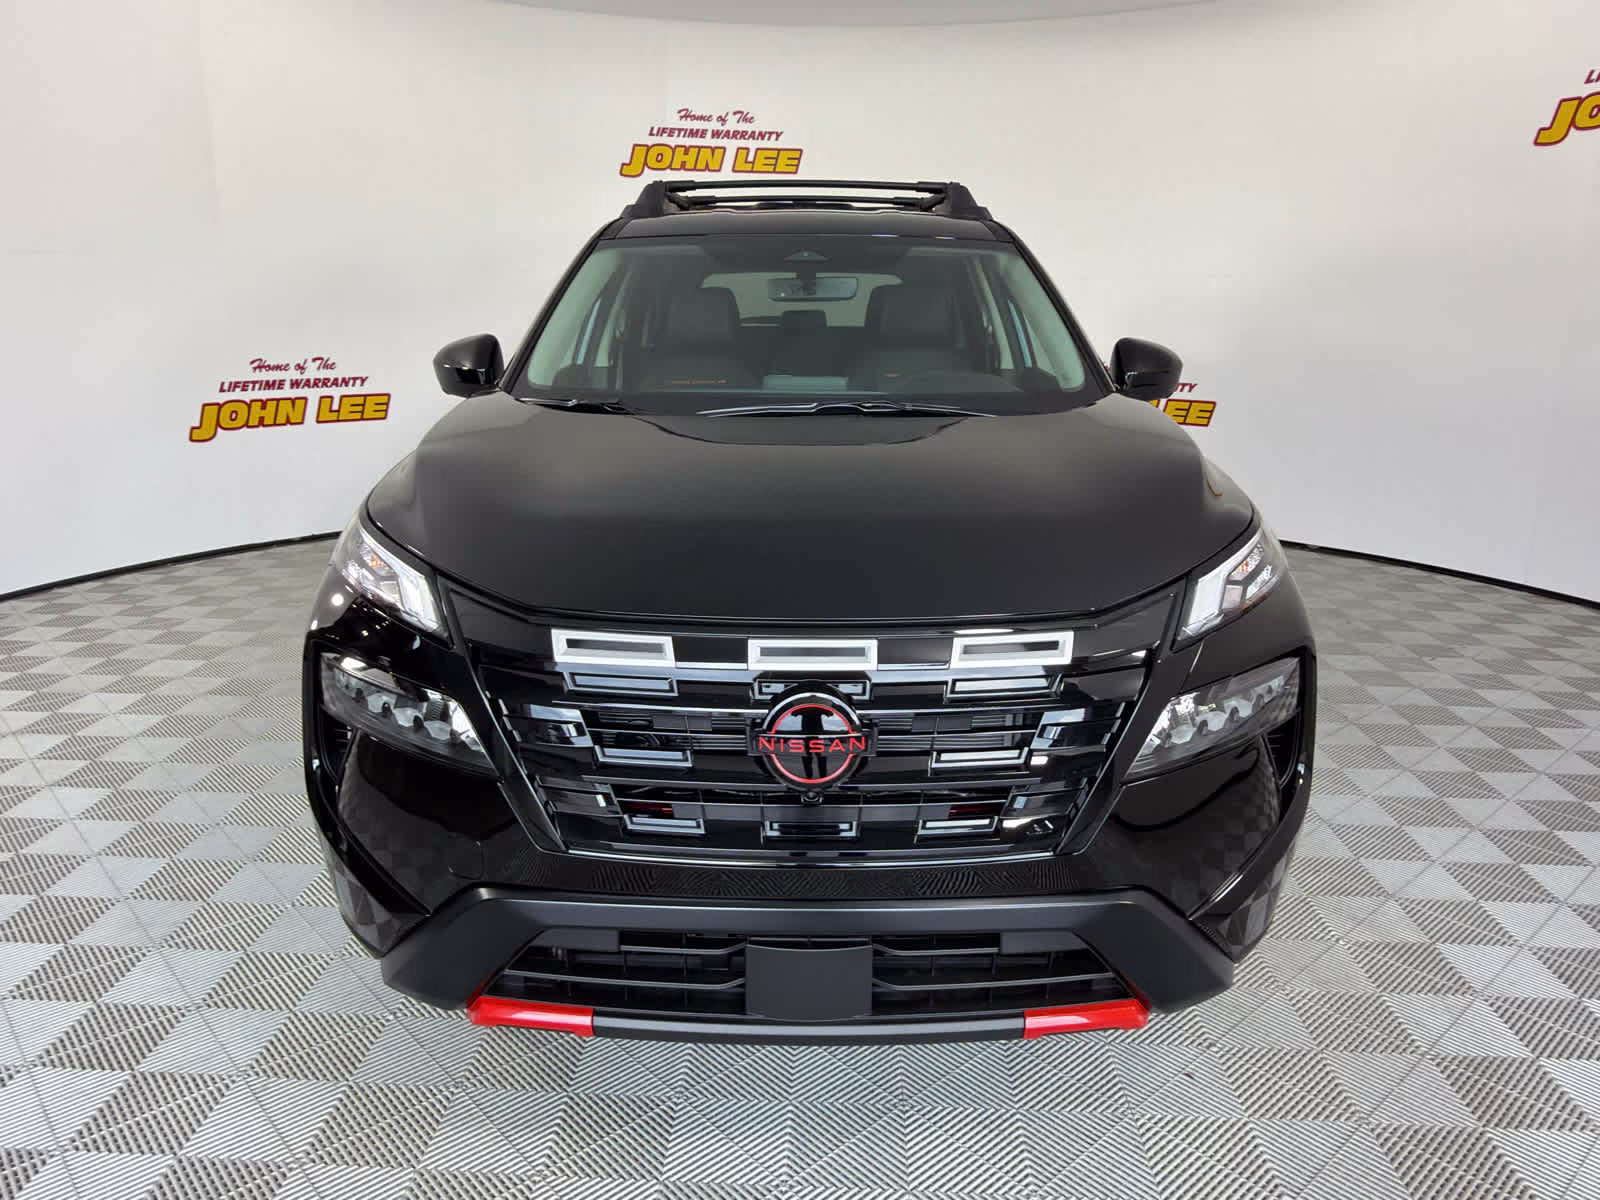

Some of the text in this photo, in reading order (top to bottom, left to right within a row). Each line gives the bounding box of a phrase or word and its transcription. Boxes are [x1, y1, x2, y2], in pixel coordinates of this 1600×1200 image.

[677, 108, 755, 126] Home of The
[648, 127, 784, 141] LIFETIME WARRANTY
[619, 143, 803, 177] JOHN LEE
[249, 357, 337, 374] Home of The
[218, 376, 369, 393] LIFETIME WARRANTY
[189, 393, 391, 443] JOHN LEE
[1150, 398, 1217, 427] EE
[758, 736, 866, 752] NISSAN
